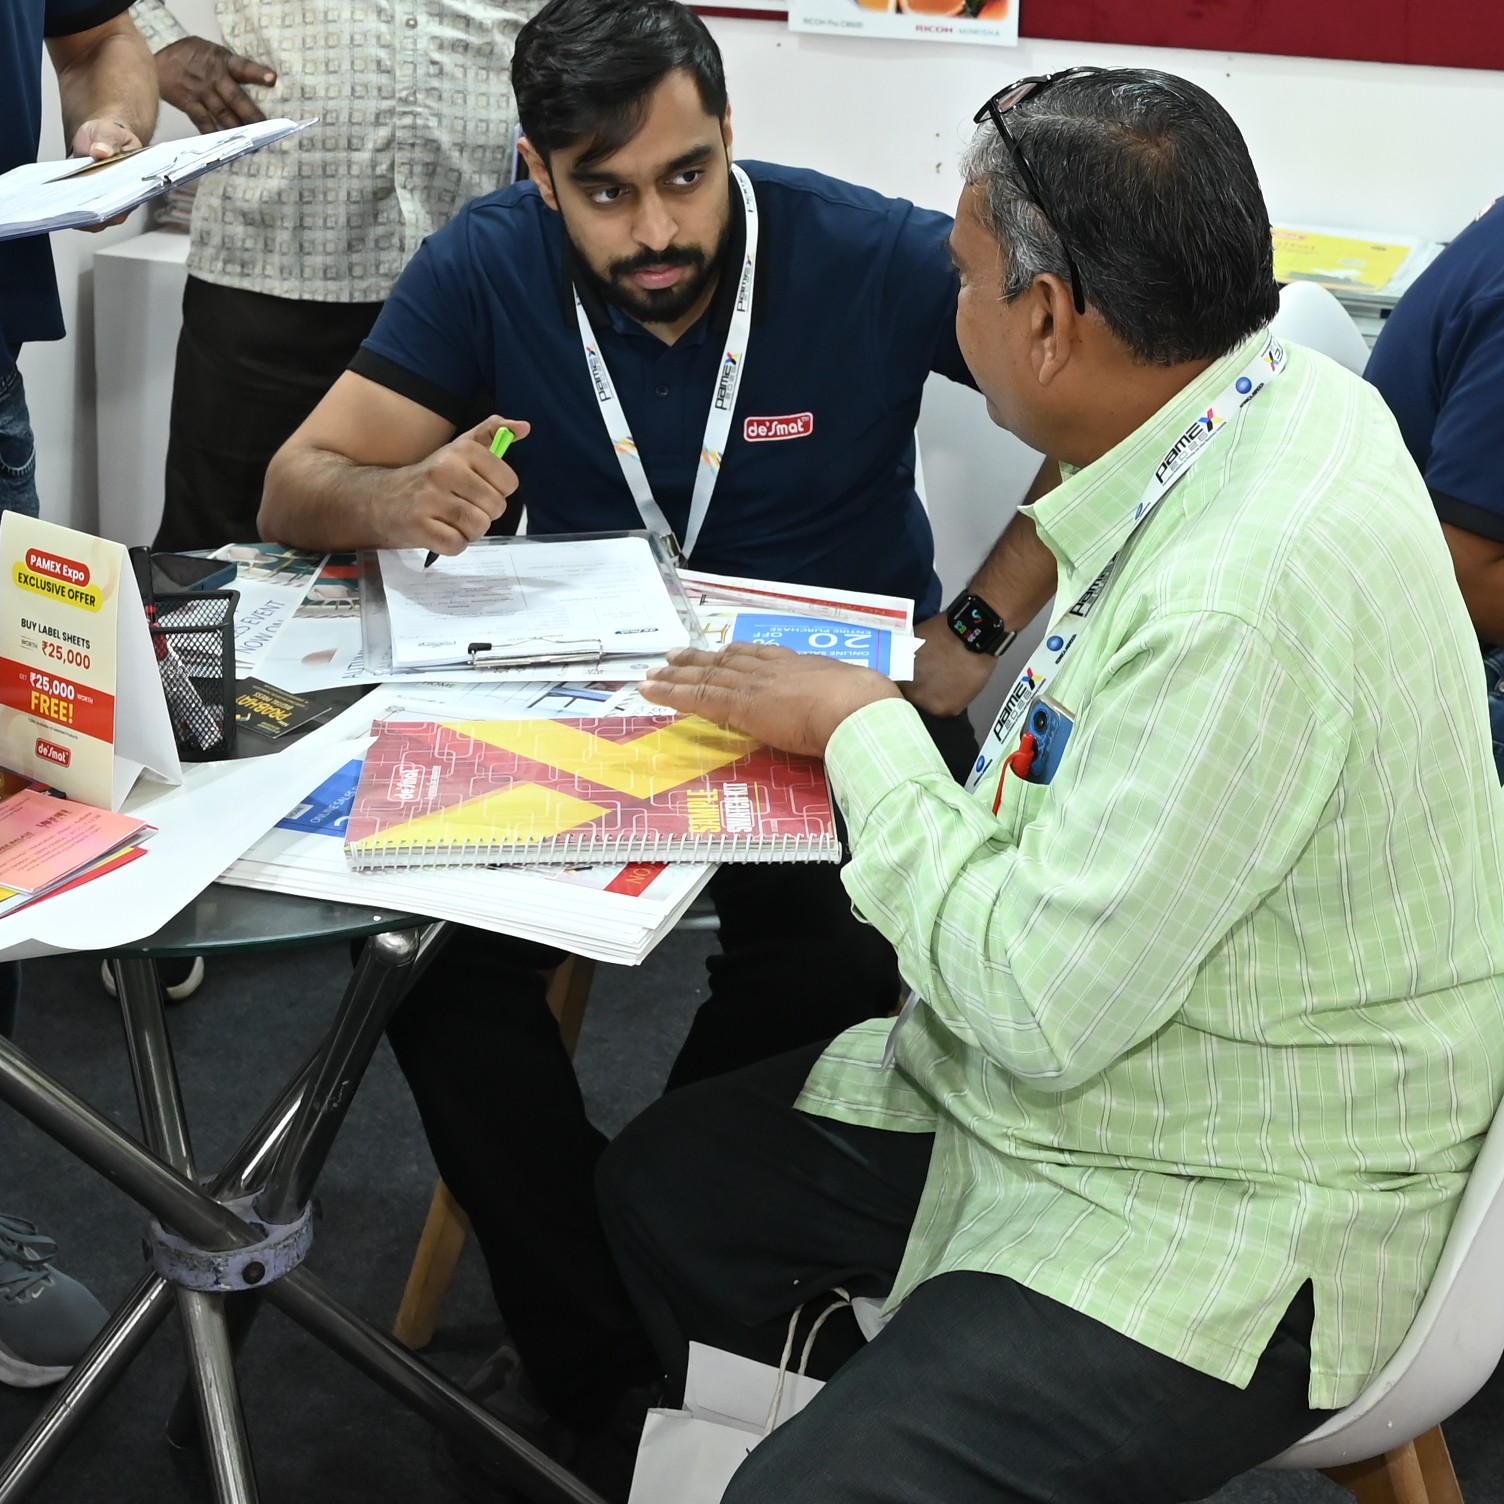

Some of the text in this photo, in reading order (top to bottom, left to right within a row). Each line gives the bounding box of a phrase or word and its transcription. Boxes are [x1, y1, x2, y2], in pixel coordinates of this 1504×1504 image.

[915, 25, 953, 34] RICOH
[30, 554, 85, 583] PAMEX Expo
[18, 572, 96, 607] EXCLUSIVE OFFER
[241, 600, 285, 625] EVENT
[21, 617, 91, 650] BUY LABEL SHEETS
[238, 632, 264, 655] NOW
[808, 633, 872, 649] 20
[42, 640, 91, 669] ₹25,000
[29, 672, 75, 700] ₹25,000
[31, 690, 74, 724] FREE!
[687, 788, 722, 834] SAMPLE
[723, 782, 753, 833] SWATCH KIT
